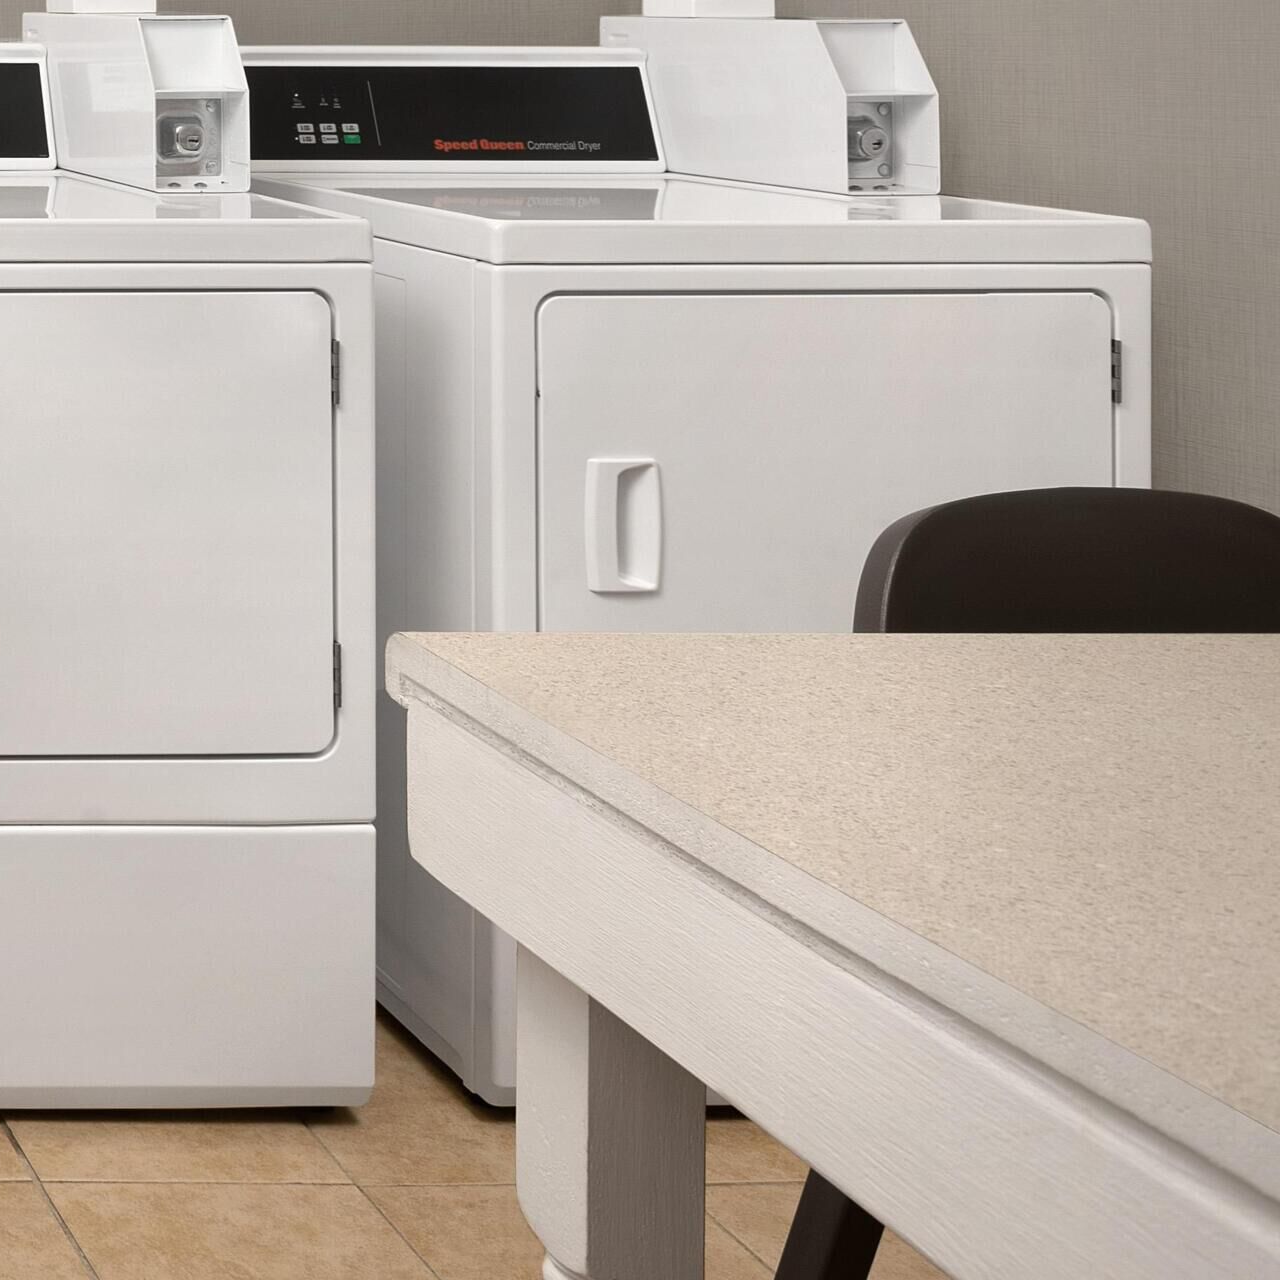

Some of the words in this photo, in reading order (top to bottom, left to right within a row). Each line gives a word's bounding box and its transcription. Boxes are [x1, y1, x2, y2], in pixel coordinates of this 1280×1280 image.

[434, 139, 478, 152] Speed
[479, 139, 524, 150] Queen
[527, 141, 576, 150] Commercial
[578, 141, 601, 152] Dryer
